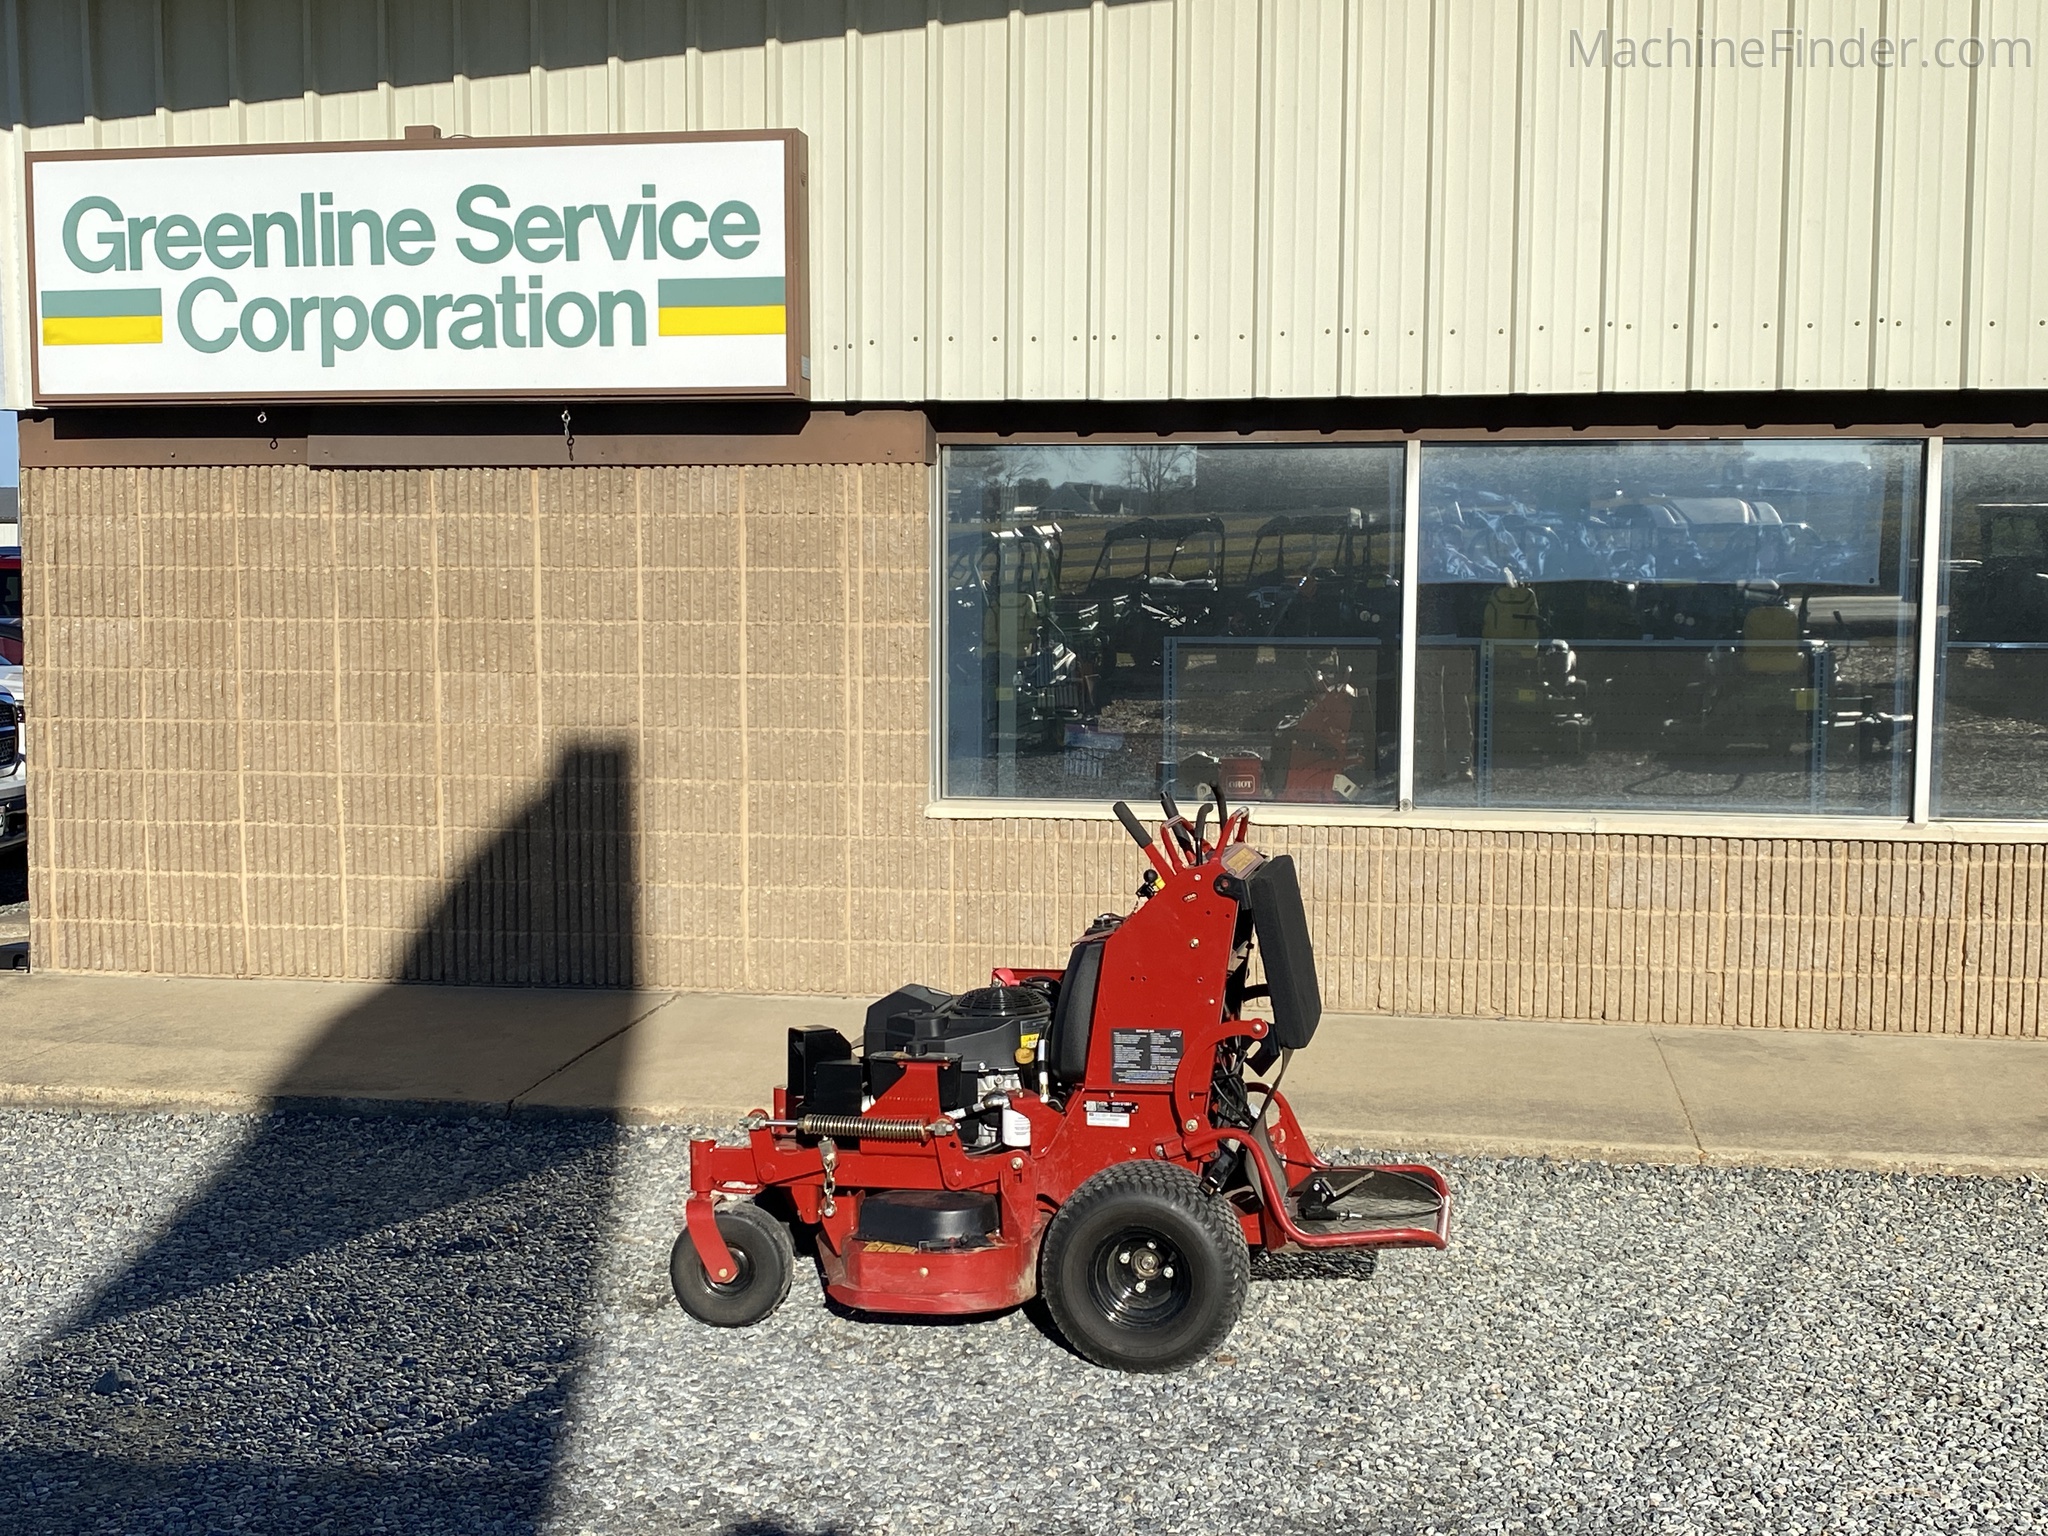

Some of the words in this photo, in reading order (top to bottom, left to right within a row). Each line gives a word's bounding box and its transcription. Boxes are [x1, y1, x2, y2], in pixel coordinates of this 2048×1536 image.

[62, 192, 435, 273] Greenline
[455, 184, 760, 263] Service
[177, 276, 647, 367] Corporation
